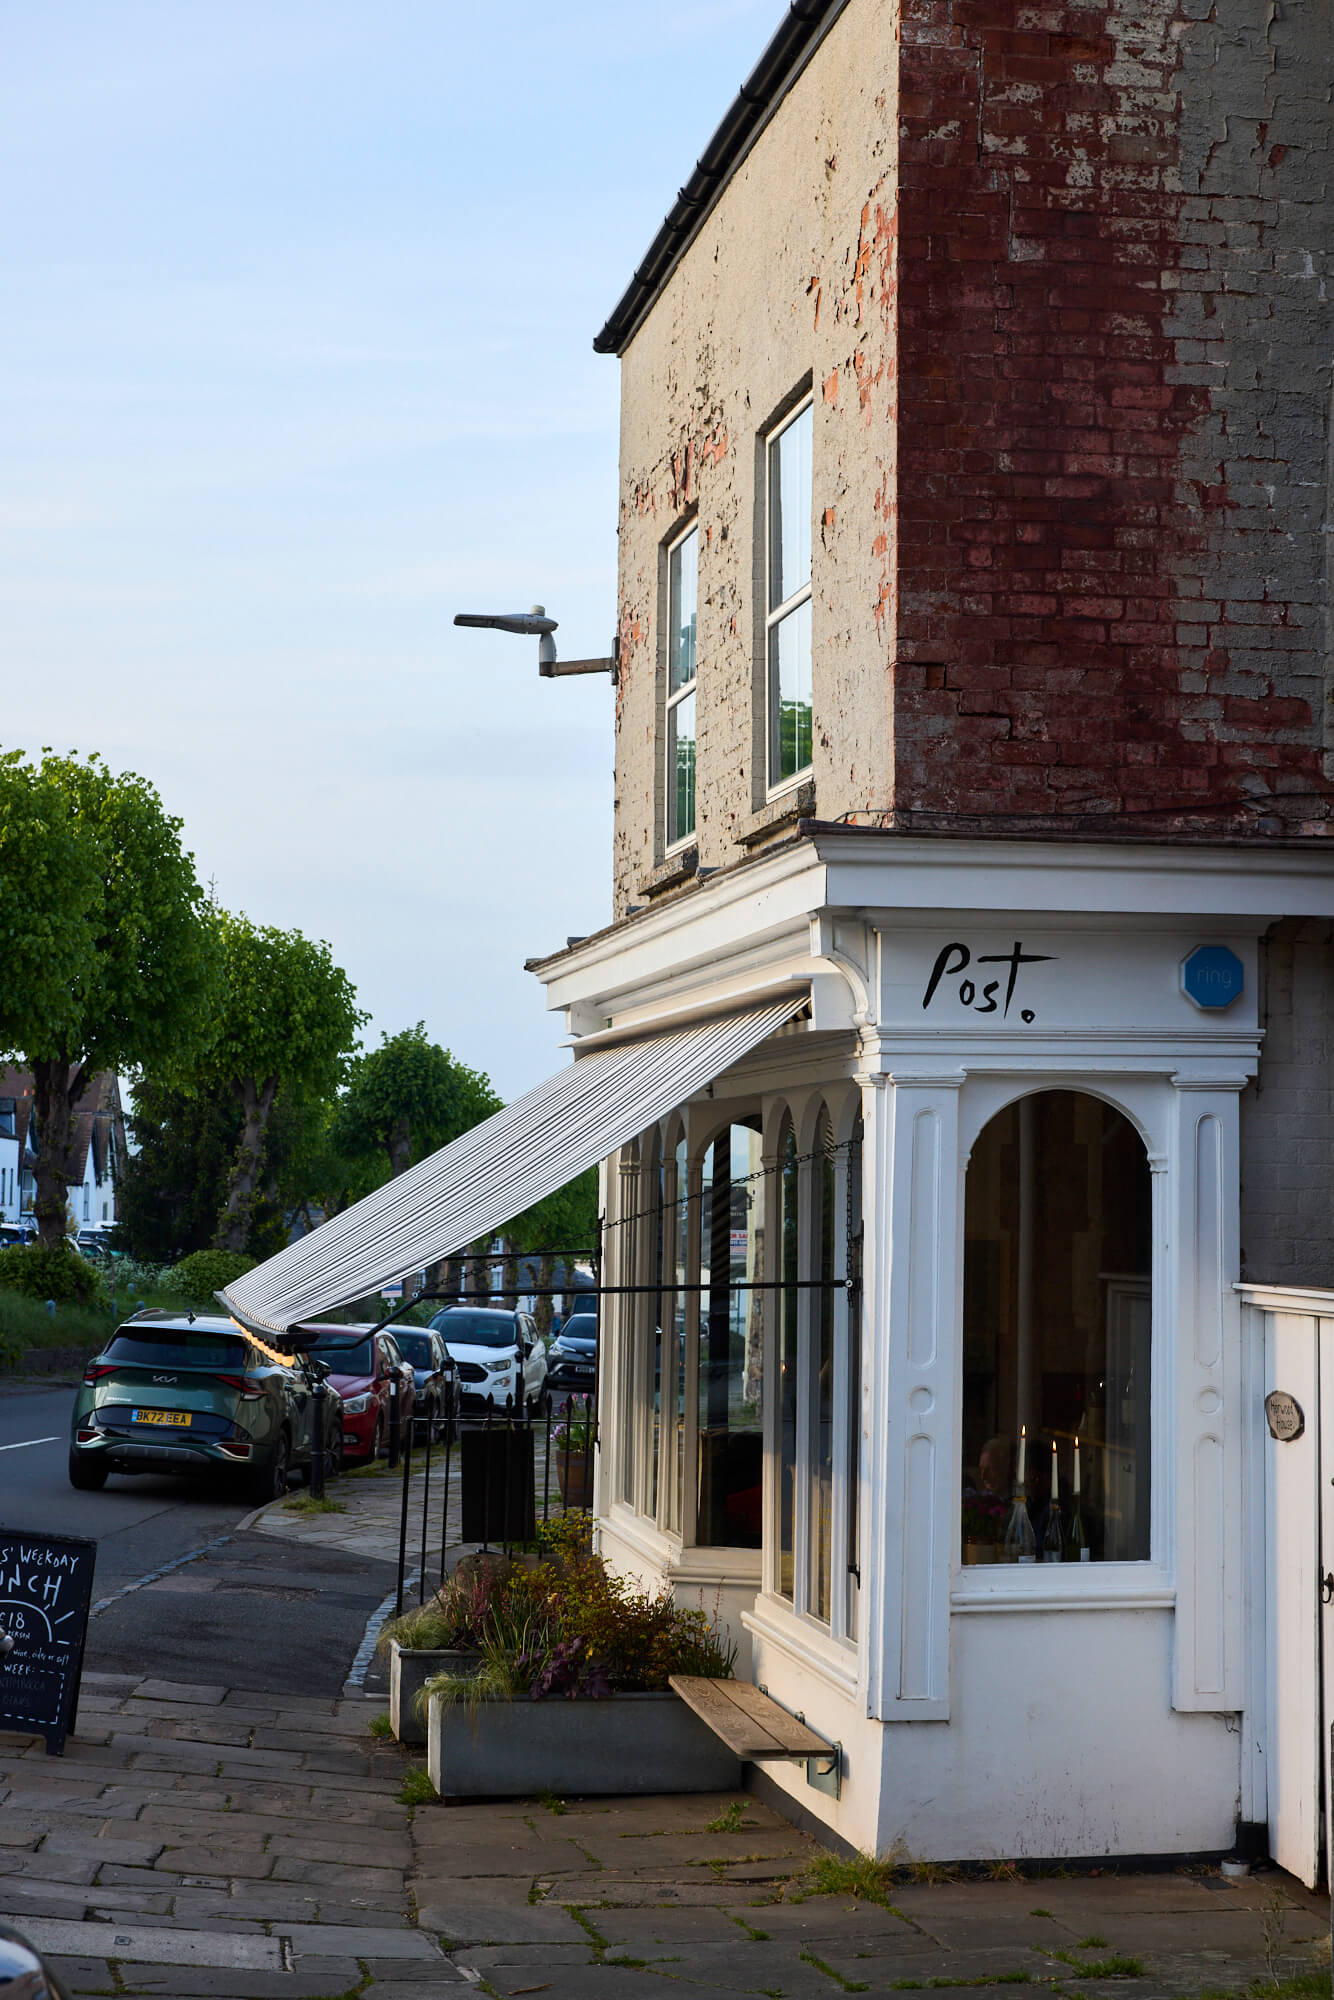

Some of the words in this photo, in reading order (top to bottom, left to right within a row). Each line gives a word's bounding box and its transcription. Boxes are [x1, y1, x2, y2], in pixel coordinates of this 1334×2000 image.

[1195, 966, 1232, 988] ring
[153, 1375, 178, 1383] KIA
[137, 1409, 165, 1422] BK72
[166, 1413, 187, 1425] EEA
[20, 1544, 80, 1574] WEEKDAY
